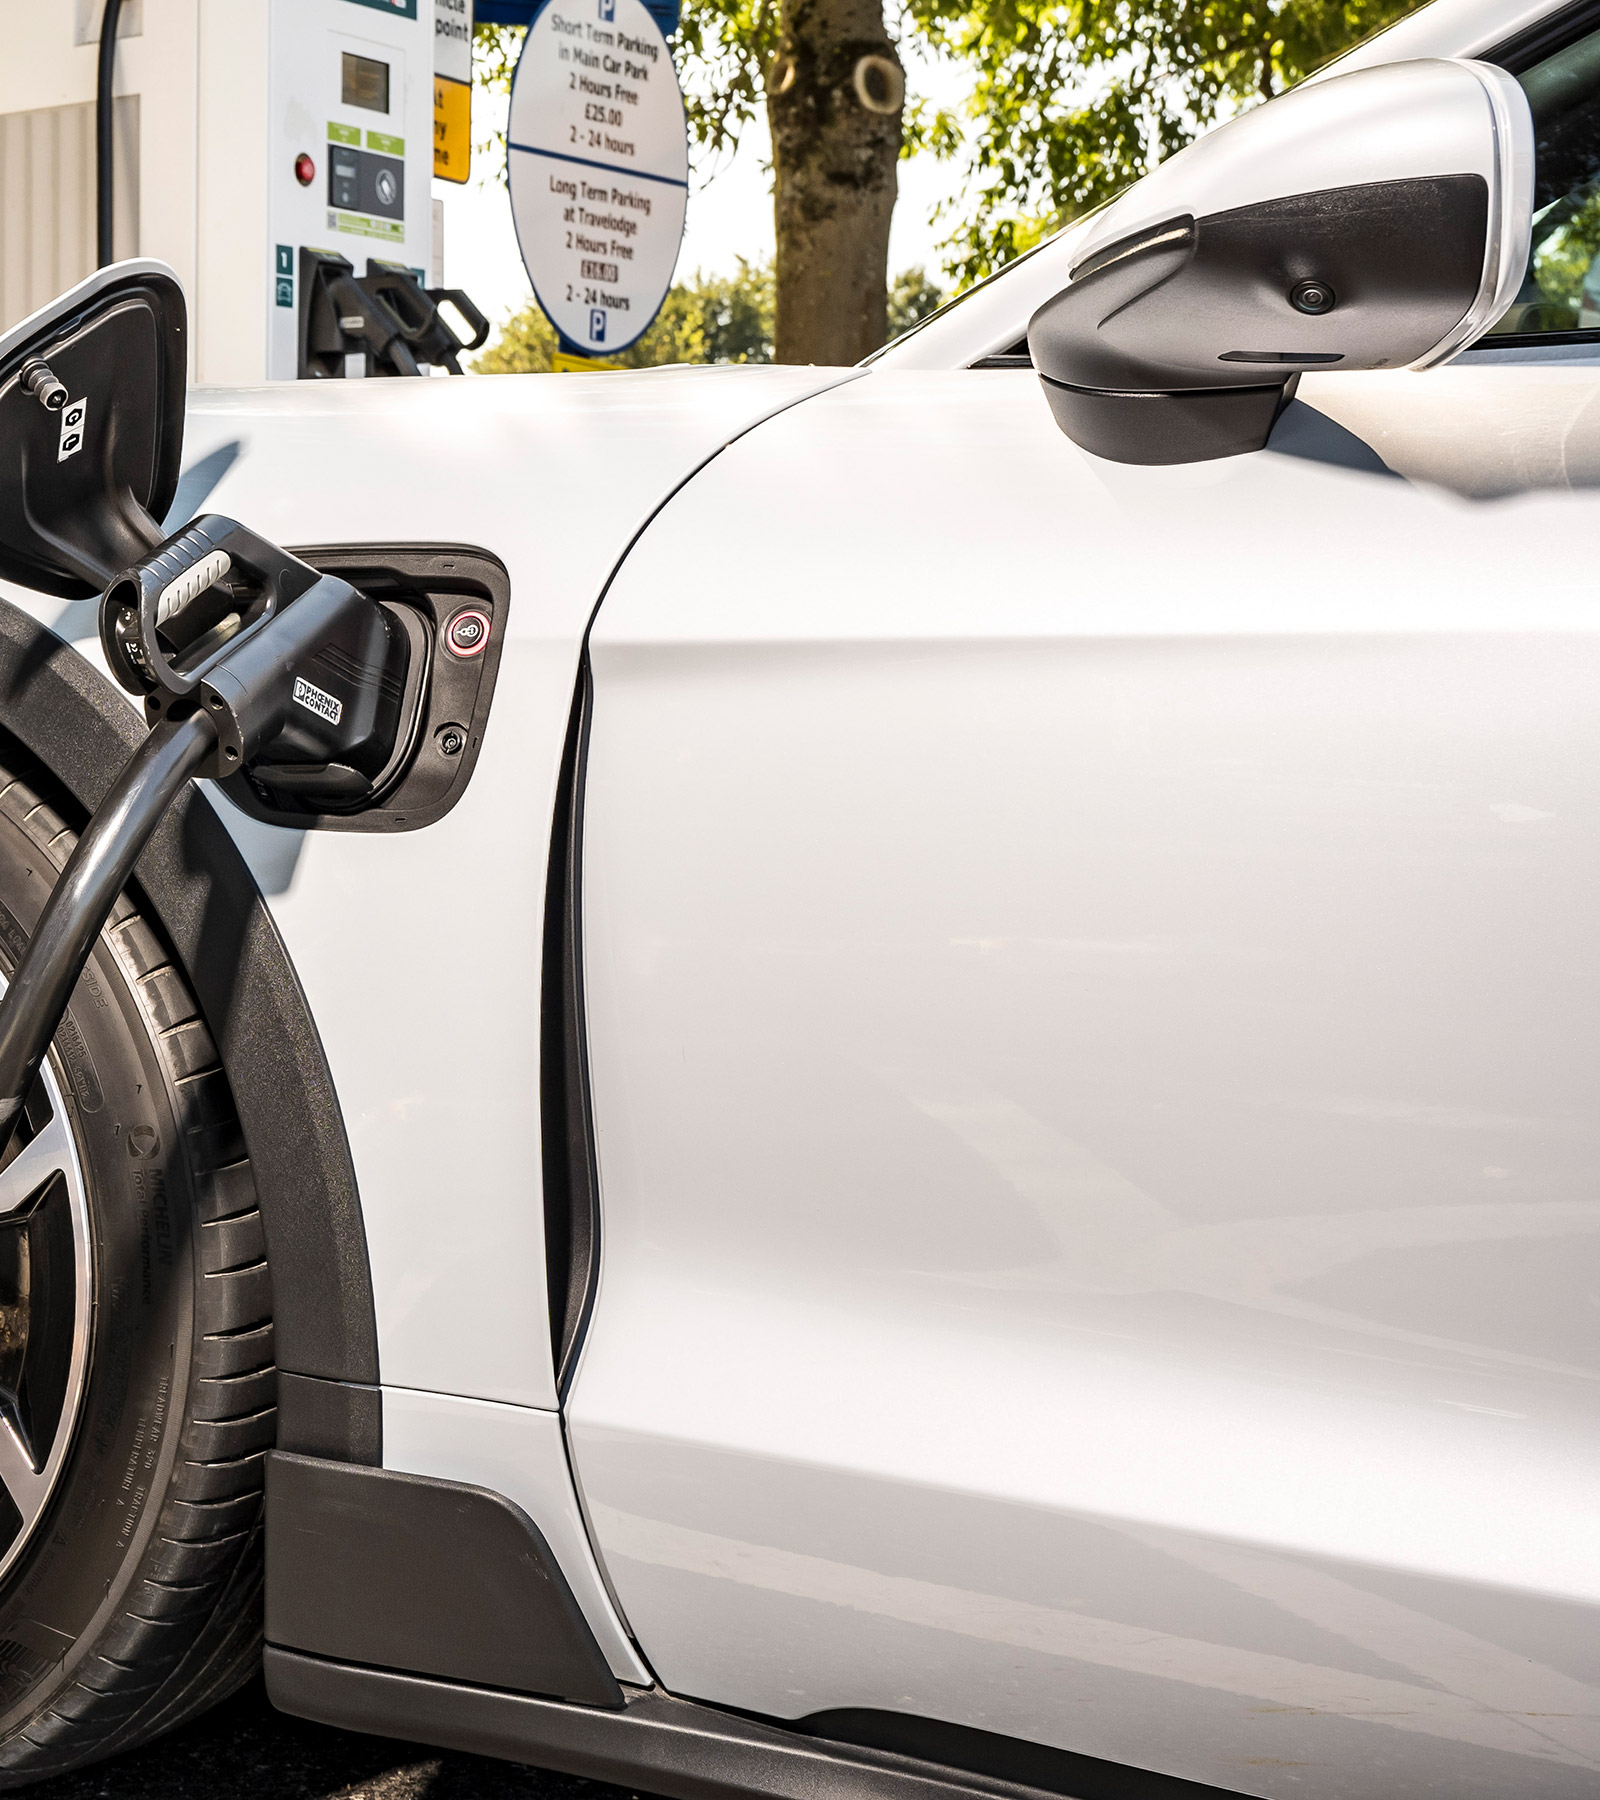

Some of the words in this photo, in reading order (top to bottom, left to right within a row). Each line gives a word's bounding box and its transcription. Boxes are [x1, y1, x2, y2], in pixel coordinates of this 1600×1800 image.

[435, 16, 469, 42] point
[551, 14, 582, 39] Short
[586, 24, 613, 45] Term
[617, 32, 659, 62] Parking
[558, 42, 569, 61] in
[572, 47, 599, 69] Main
[603, 55, 621, 74] Car
[625, 62, 648, 81] Park
[569, 72, 576, 90] 2
[579, 76, 611, 98] Hours
[615, 84, 639, 106] Free
[569, 125, 577, 143] 2
[588, 130, 602, 148] 24
[604, 133, 635, 156] hours
[550, 175, 577, 201] Long
[580, 181, 608, 202] Term
[611, 188, 652, 216] Parking
[563, 207, 575, 224] at
[578, 207, 638, 238] Travelodge
[280, 251, 288, 269] 1
[565, 232, 573, 249] 2
[575, 234, 607, 256] Hours
[611, 240, 634, 260] Free
[566, 285, 573, 302] 2
[584, 288, 597, 306] 24
[600, 289, 630, 311] hours
[305, 696, 338, 721] CONTACT
[149, 1168, 173, 1266] MICHELIN
[150, 1375, 170, 1443] TREADWEAR
[121, 1418, 148, 1491] TEMPERATURE
[121, 1486, 146, 1537] TRACTION
